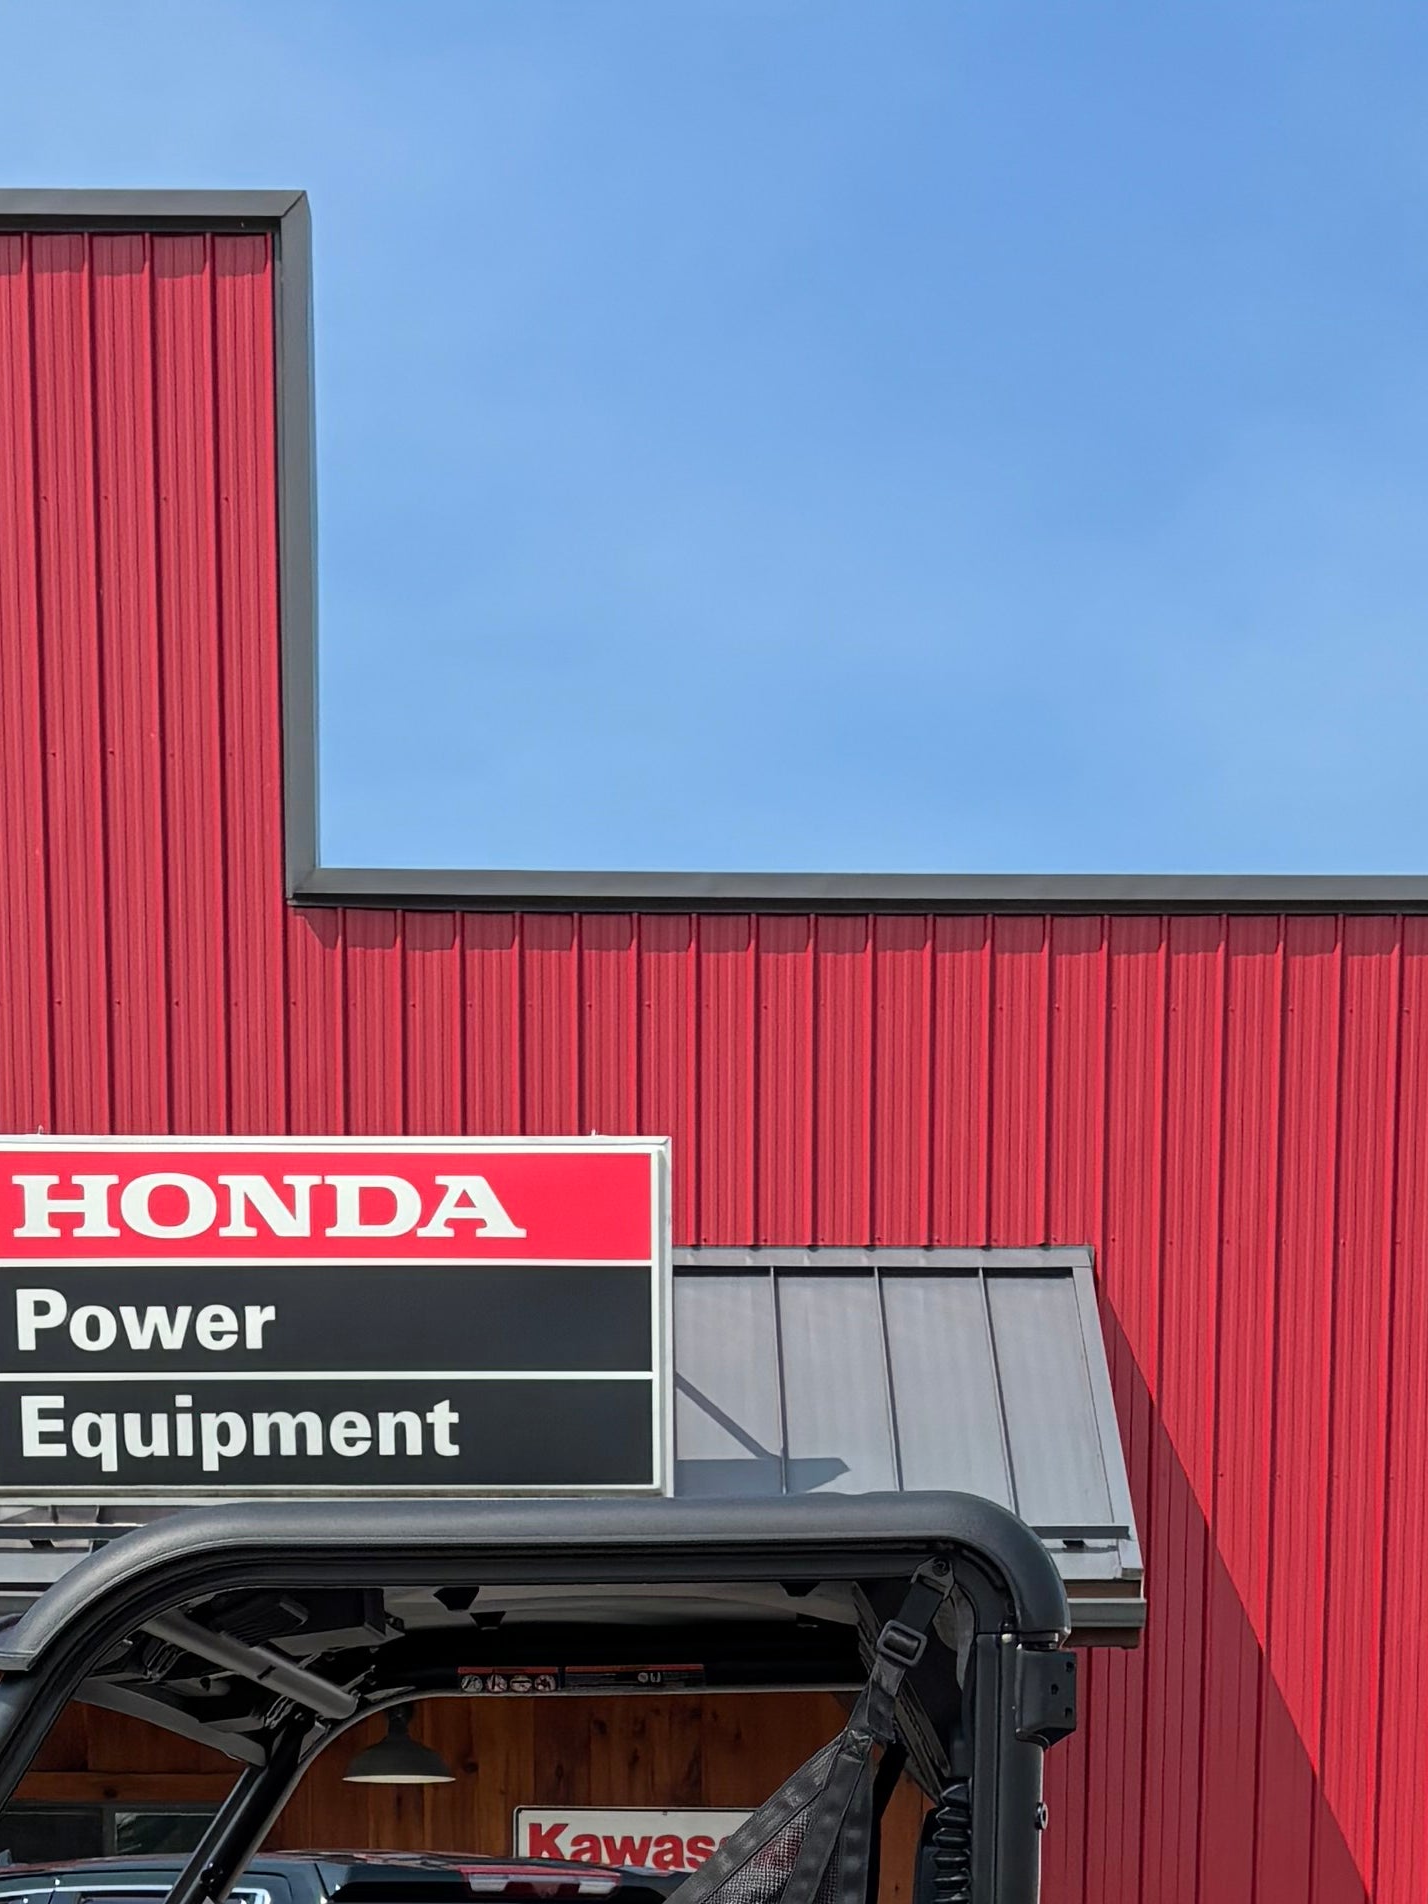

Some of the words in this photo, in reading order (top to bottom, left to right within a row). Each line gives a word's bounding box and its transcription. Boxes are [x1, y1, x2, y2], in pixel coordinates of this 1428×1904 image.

[12, 1173, 527, 1240] HONDA
[15, 1288, 276, 1352] Power
[20, 1394, 460, 1472] Equipment
[528, 1822, 728, 1872] Kawas
